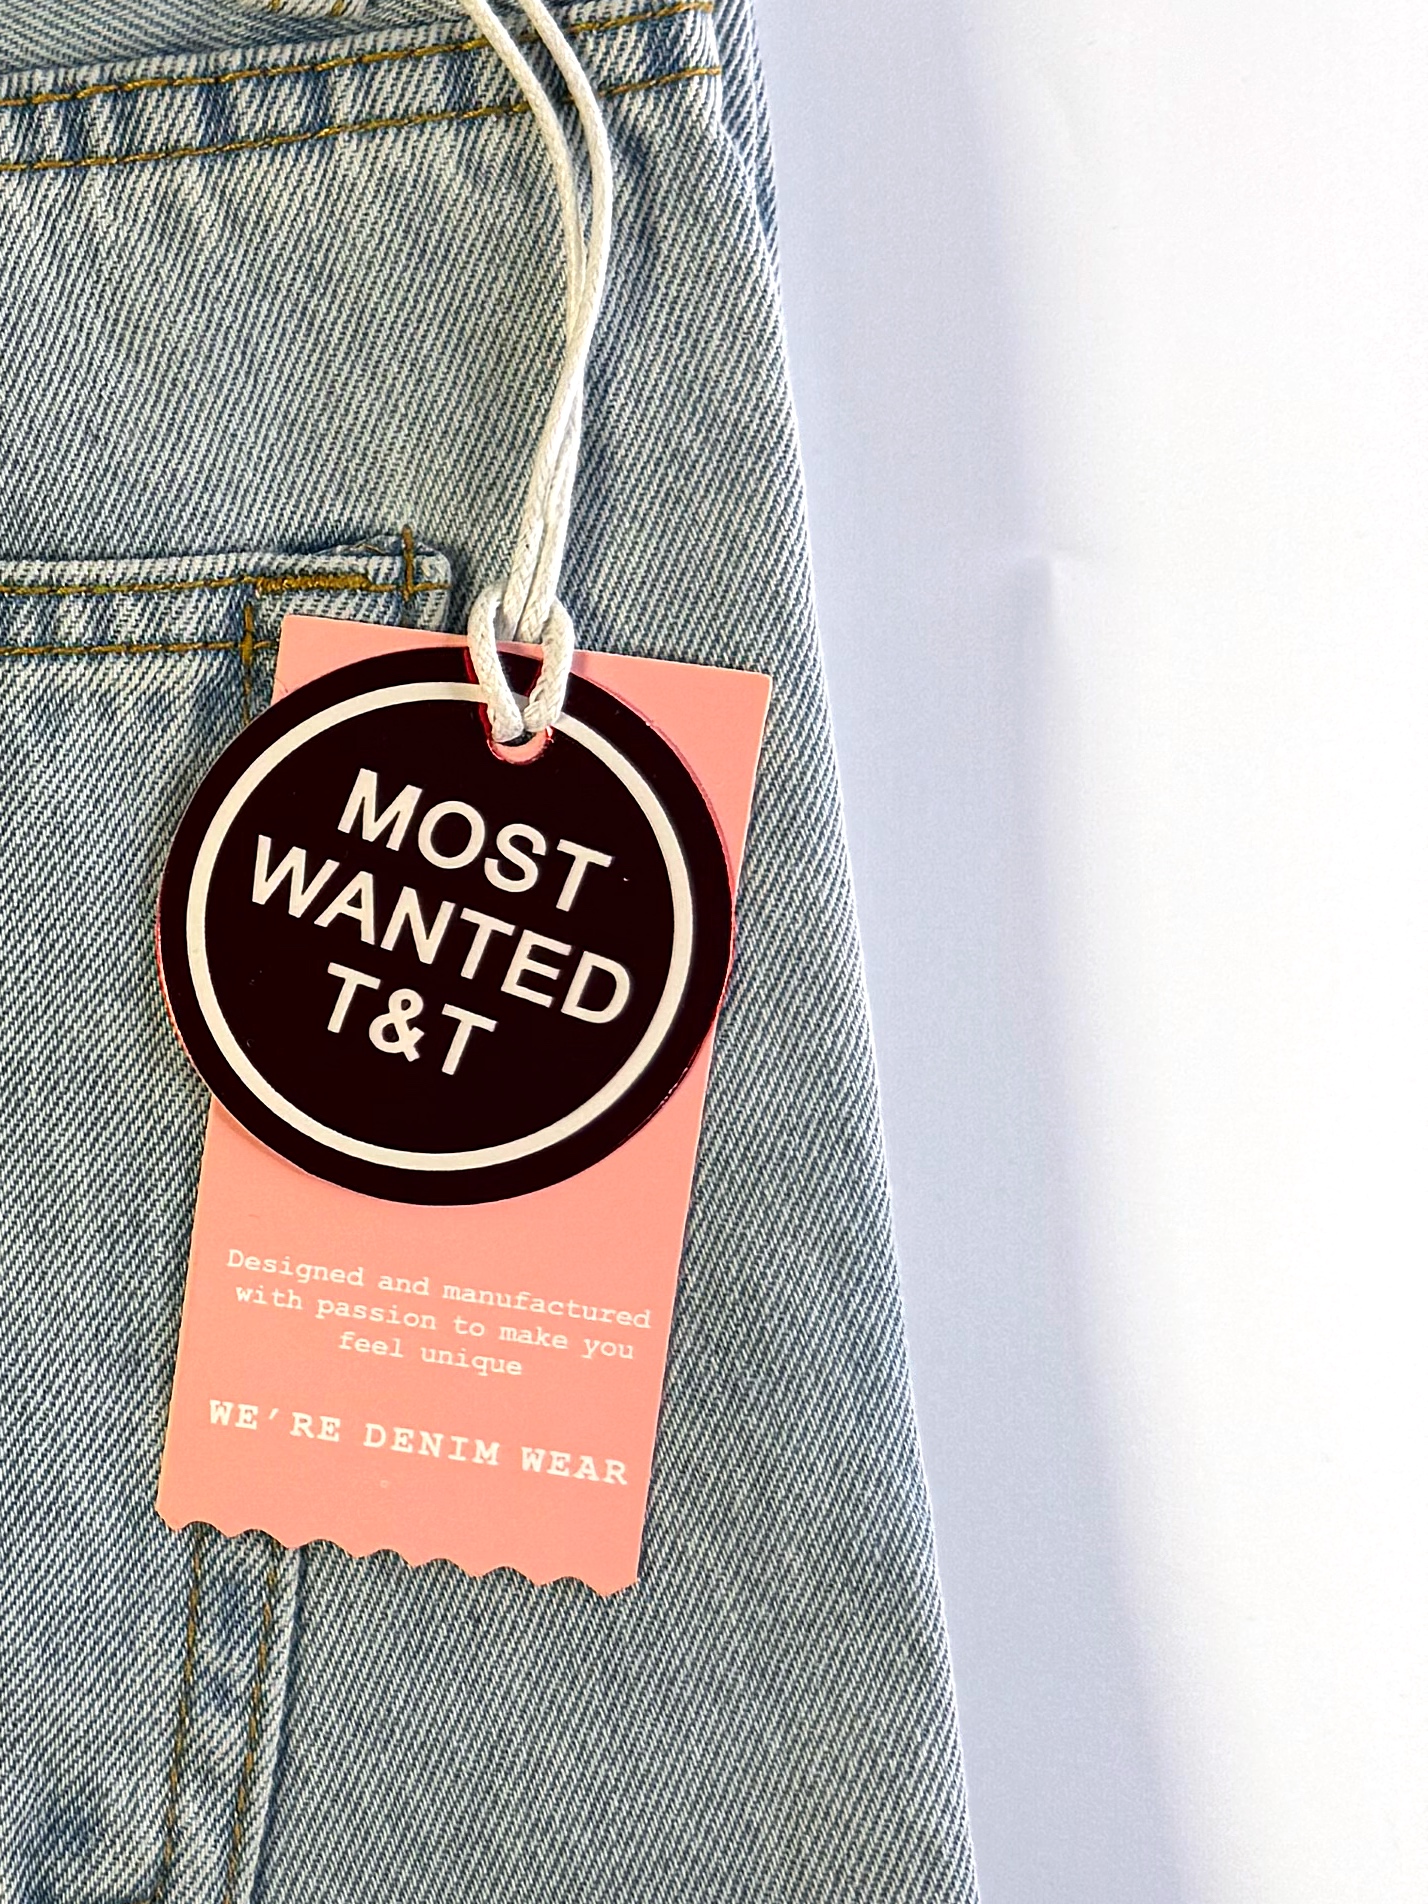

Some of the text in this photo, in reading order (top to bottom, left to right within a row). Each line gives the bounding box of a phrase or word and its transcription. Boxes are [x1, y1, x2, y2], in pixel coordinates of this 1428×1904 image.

[336, 766, 613, 912] MOST
[250, 833, 631, 1024] WANTED
[326, 961, 498, 1076] T&T
[225, 1247, 651, 1329] Designed and manufactured
[234, 1283, 634, 1360] with passion to make you
[338, 1330, 523, 1377] feel unique
[208, 1398, 628, 1486] WE'RE DENIM WEAR
